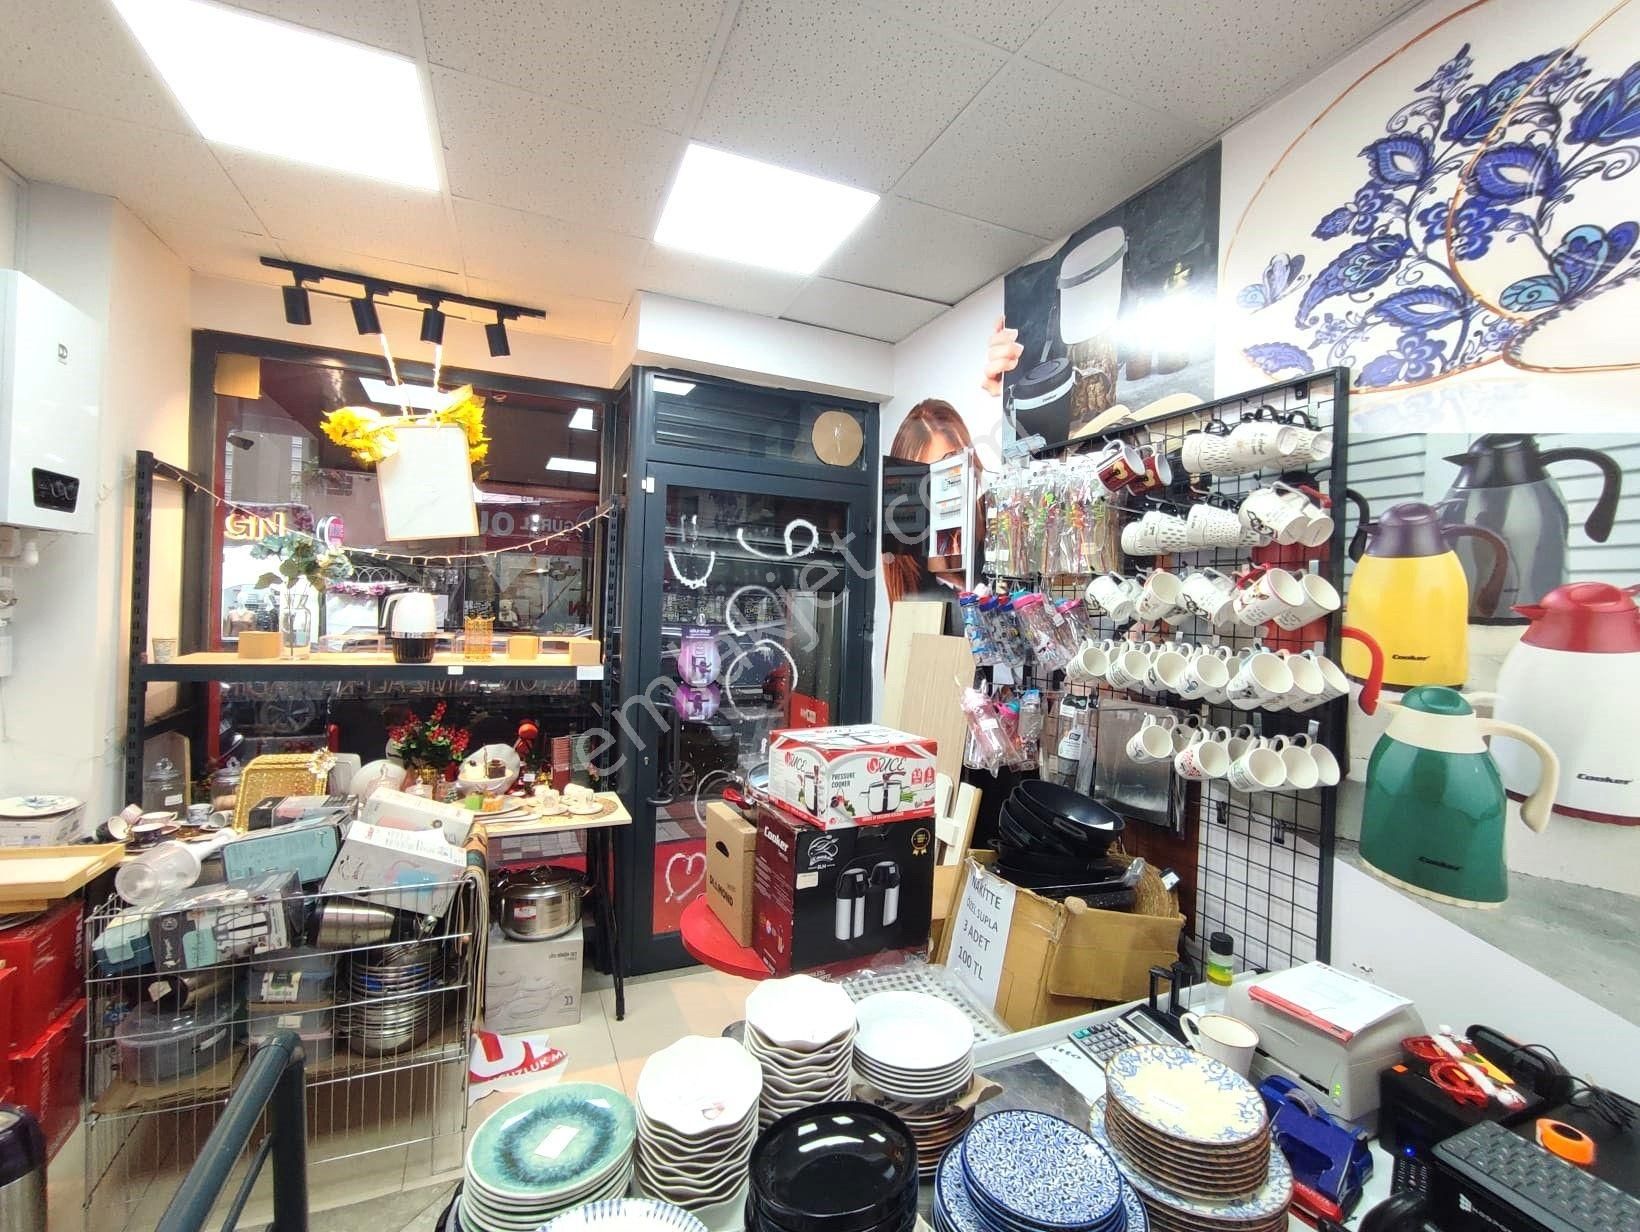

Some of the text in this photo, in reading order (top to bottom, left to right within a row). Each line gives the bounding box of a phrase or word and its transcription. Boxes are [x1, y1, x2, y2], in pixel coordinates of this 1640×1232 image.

[1391, 653, 1431, 662] Cooker
[831, 772, 855, 781] PRESSURE
[831, 780, 851, 789] COOKER
[1576, 773, 1634, 785] Cooker
[764, 825, 789, 852] Cooker
[971, 874, 1002, 910] NAKİTTE
[977, 908, 999, 932] SUPLA
[963, 920, 991, 951] 3 ADET
[958, 946, 984, 981] 100 TL
